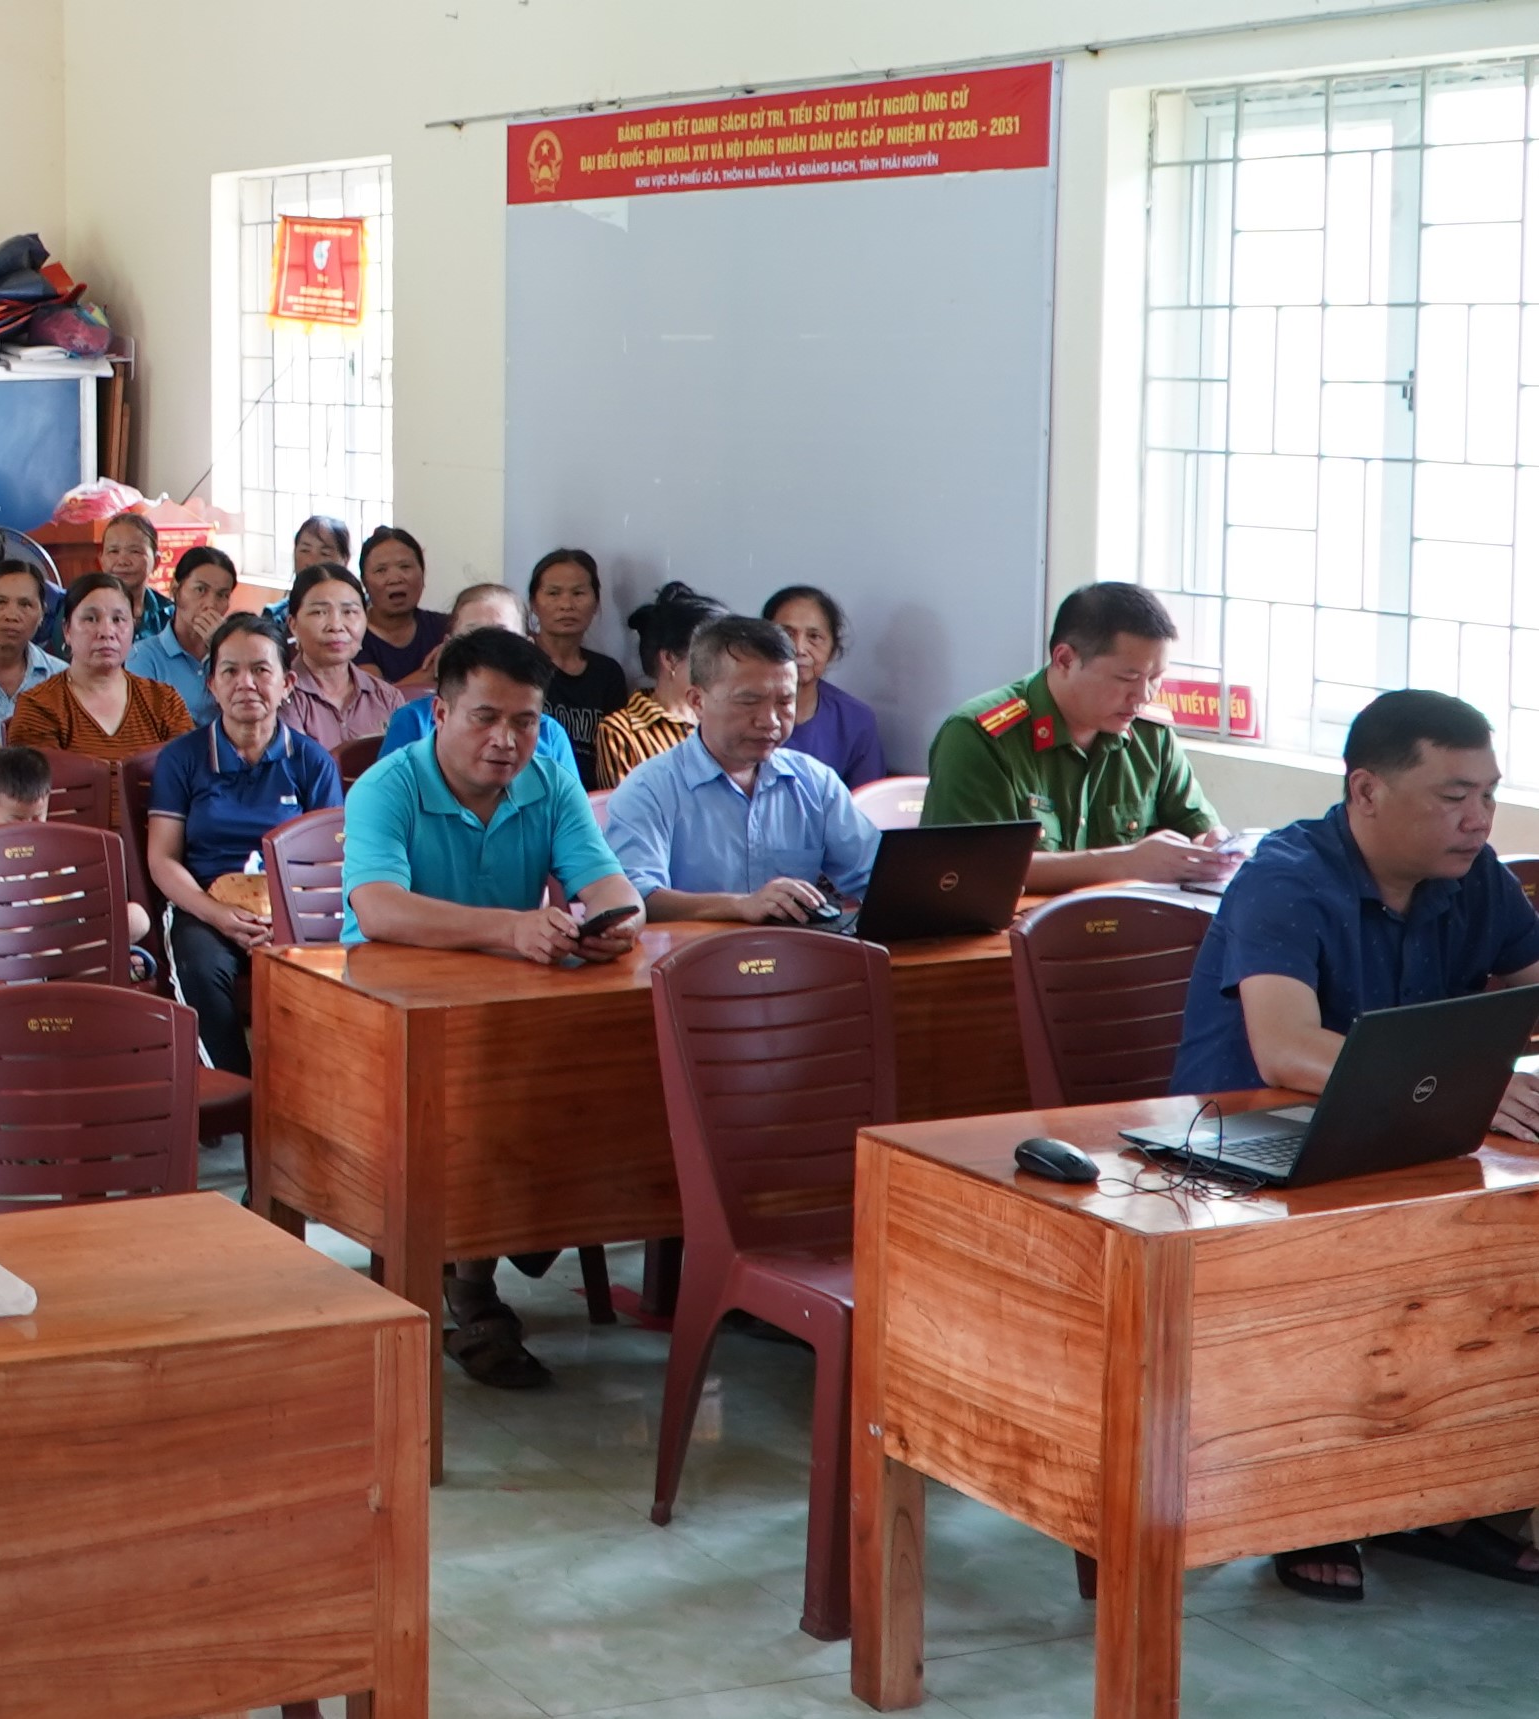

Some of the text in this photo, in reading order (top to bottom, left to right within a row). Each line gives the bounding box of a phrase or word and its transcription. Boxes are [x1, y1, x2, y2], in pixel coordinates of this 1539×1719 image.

[618, 121, 643, 143] BẢNG
[645, 119, 670, 140] NIÊM
[671, 115, 689, 137] YẾT
[691, 116, 718, 135] DANH
[720, 112, 748, 132] SÁCH
[750, 106, 766, 129] CỬ
[767, 109, 786, 129] TRI,
[815, 99, 832, 123] SỬ
[833, 99, 857, 121] TÓM
[860, 93, 880, 118] TẮT
[883, 91, 920, 116] NGƯỜI
[922, 90, 948, 112] ỨNG
[951, 84, 970, 110] CỬ
[580, 154, 596, 175] ĐẠI
[619, 145, 645, 169] QUỐC
[646, 145, 662, 168] HỘI
[692, 144, 708, 161] XVI
[711, 139, 724, 160] VÀ
[726, 138, 743, 162] HỘI
[777, 132, 807, 154] NHÂN
[810, 130, 832, 151] DÂN
[835, 128, 859, 149] CÁC
[861, 122, 884, 147] CẤP
[887, 121, 926, 147] NHIỆM
[928, 119, 945, 142] KỲ
[947, 119, 978, 140] 2026
[989, 115, 1020, 137] 2031
[636, 176, 651, 188] KHU
[652, 174, 667, 189] VỰC
[680, 168, 701, 185] PHIẾU
[799, 158, 830, 176] QUẢNG
[880, 153, 901, 169] THÁI
[902, 150, 939, 168] NGUYÊN
[1179, 689, 1205, 715] VIẾT
[1208, 692, 1246, 719] PẾU
